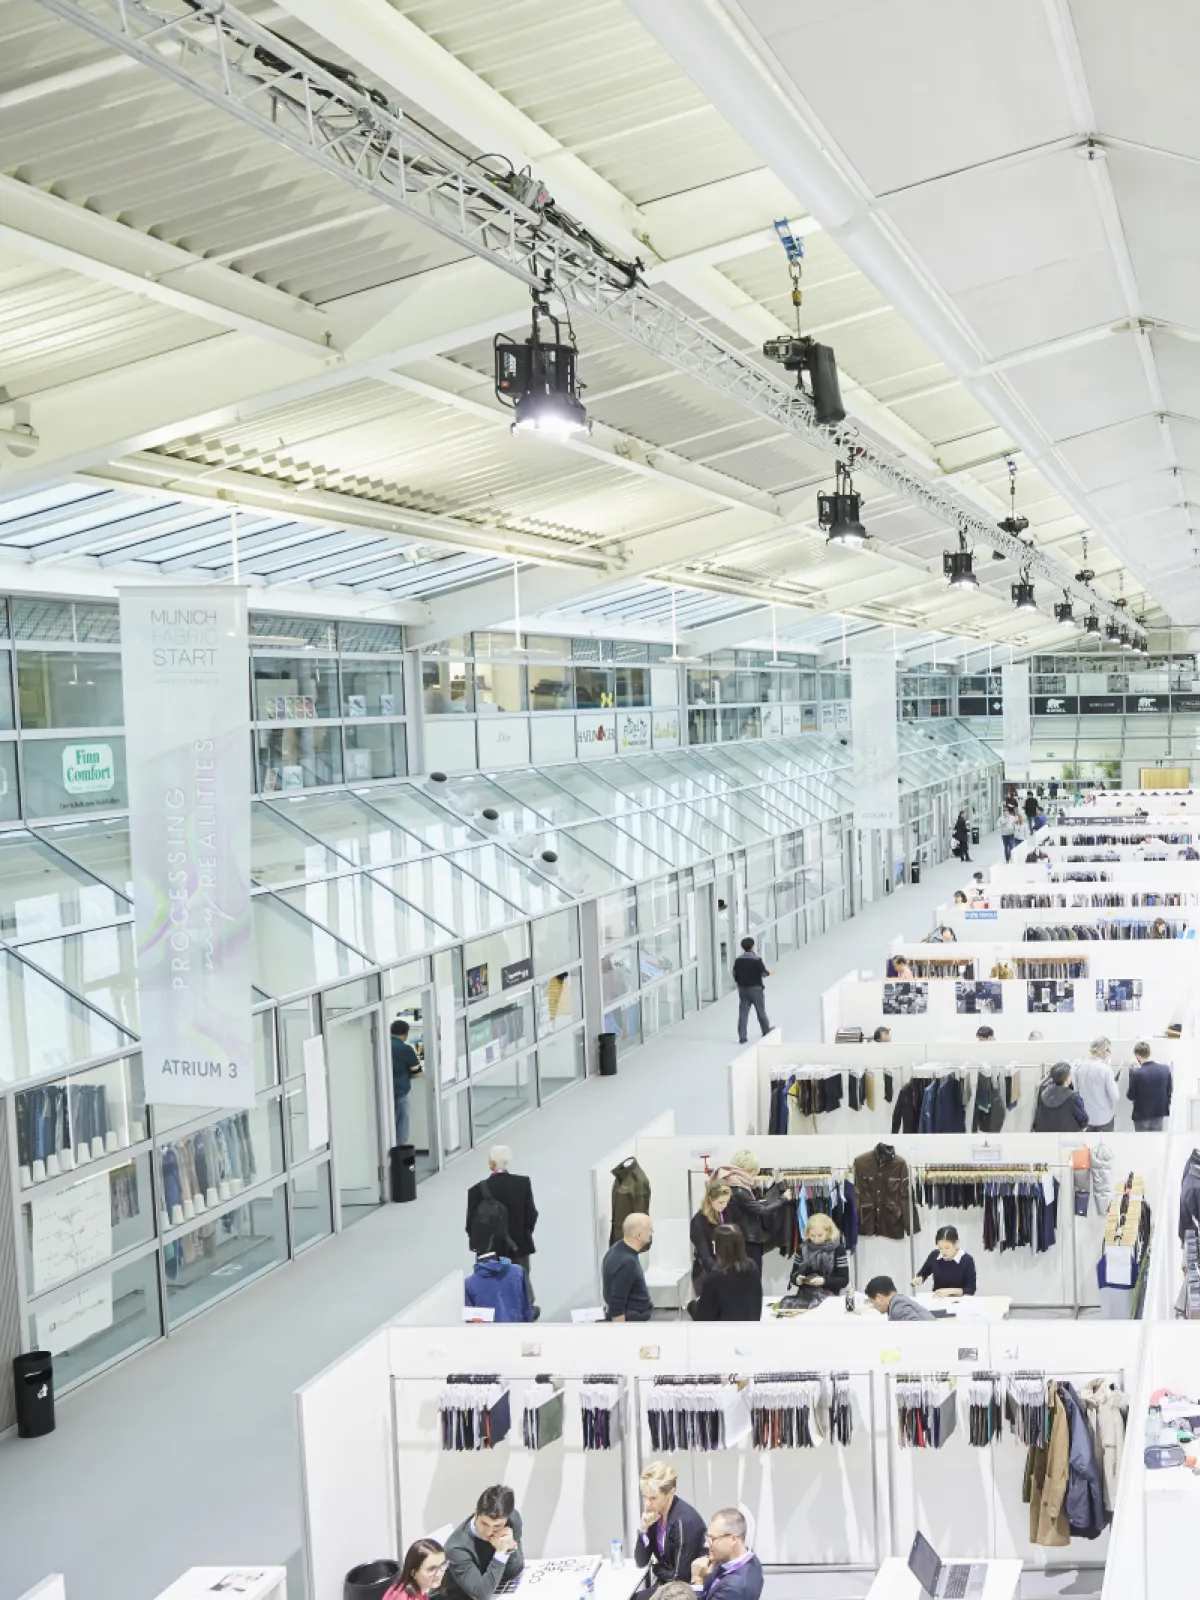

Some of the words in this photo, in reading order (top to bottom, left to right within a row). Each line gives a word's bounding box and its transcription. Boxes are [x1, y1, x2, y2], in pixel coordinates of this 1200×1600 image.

[150, 609, 217, 626] MUNICH
[152, 627, 219, 646] FABRIC
[152, 647, 218, 667] START
[75, 749, 100, 765] Finn
[67, 765, 111, 783] Comfort
[195, 738, 218, 888] REALITIES
[165, 788, 191, 991] PROCESSING
[203, 889, 236, 970] my
[161, 1058, 222, 1078] ATRIUM
[228, 1062, 238, 1079] 3
